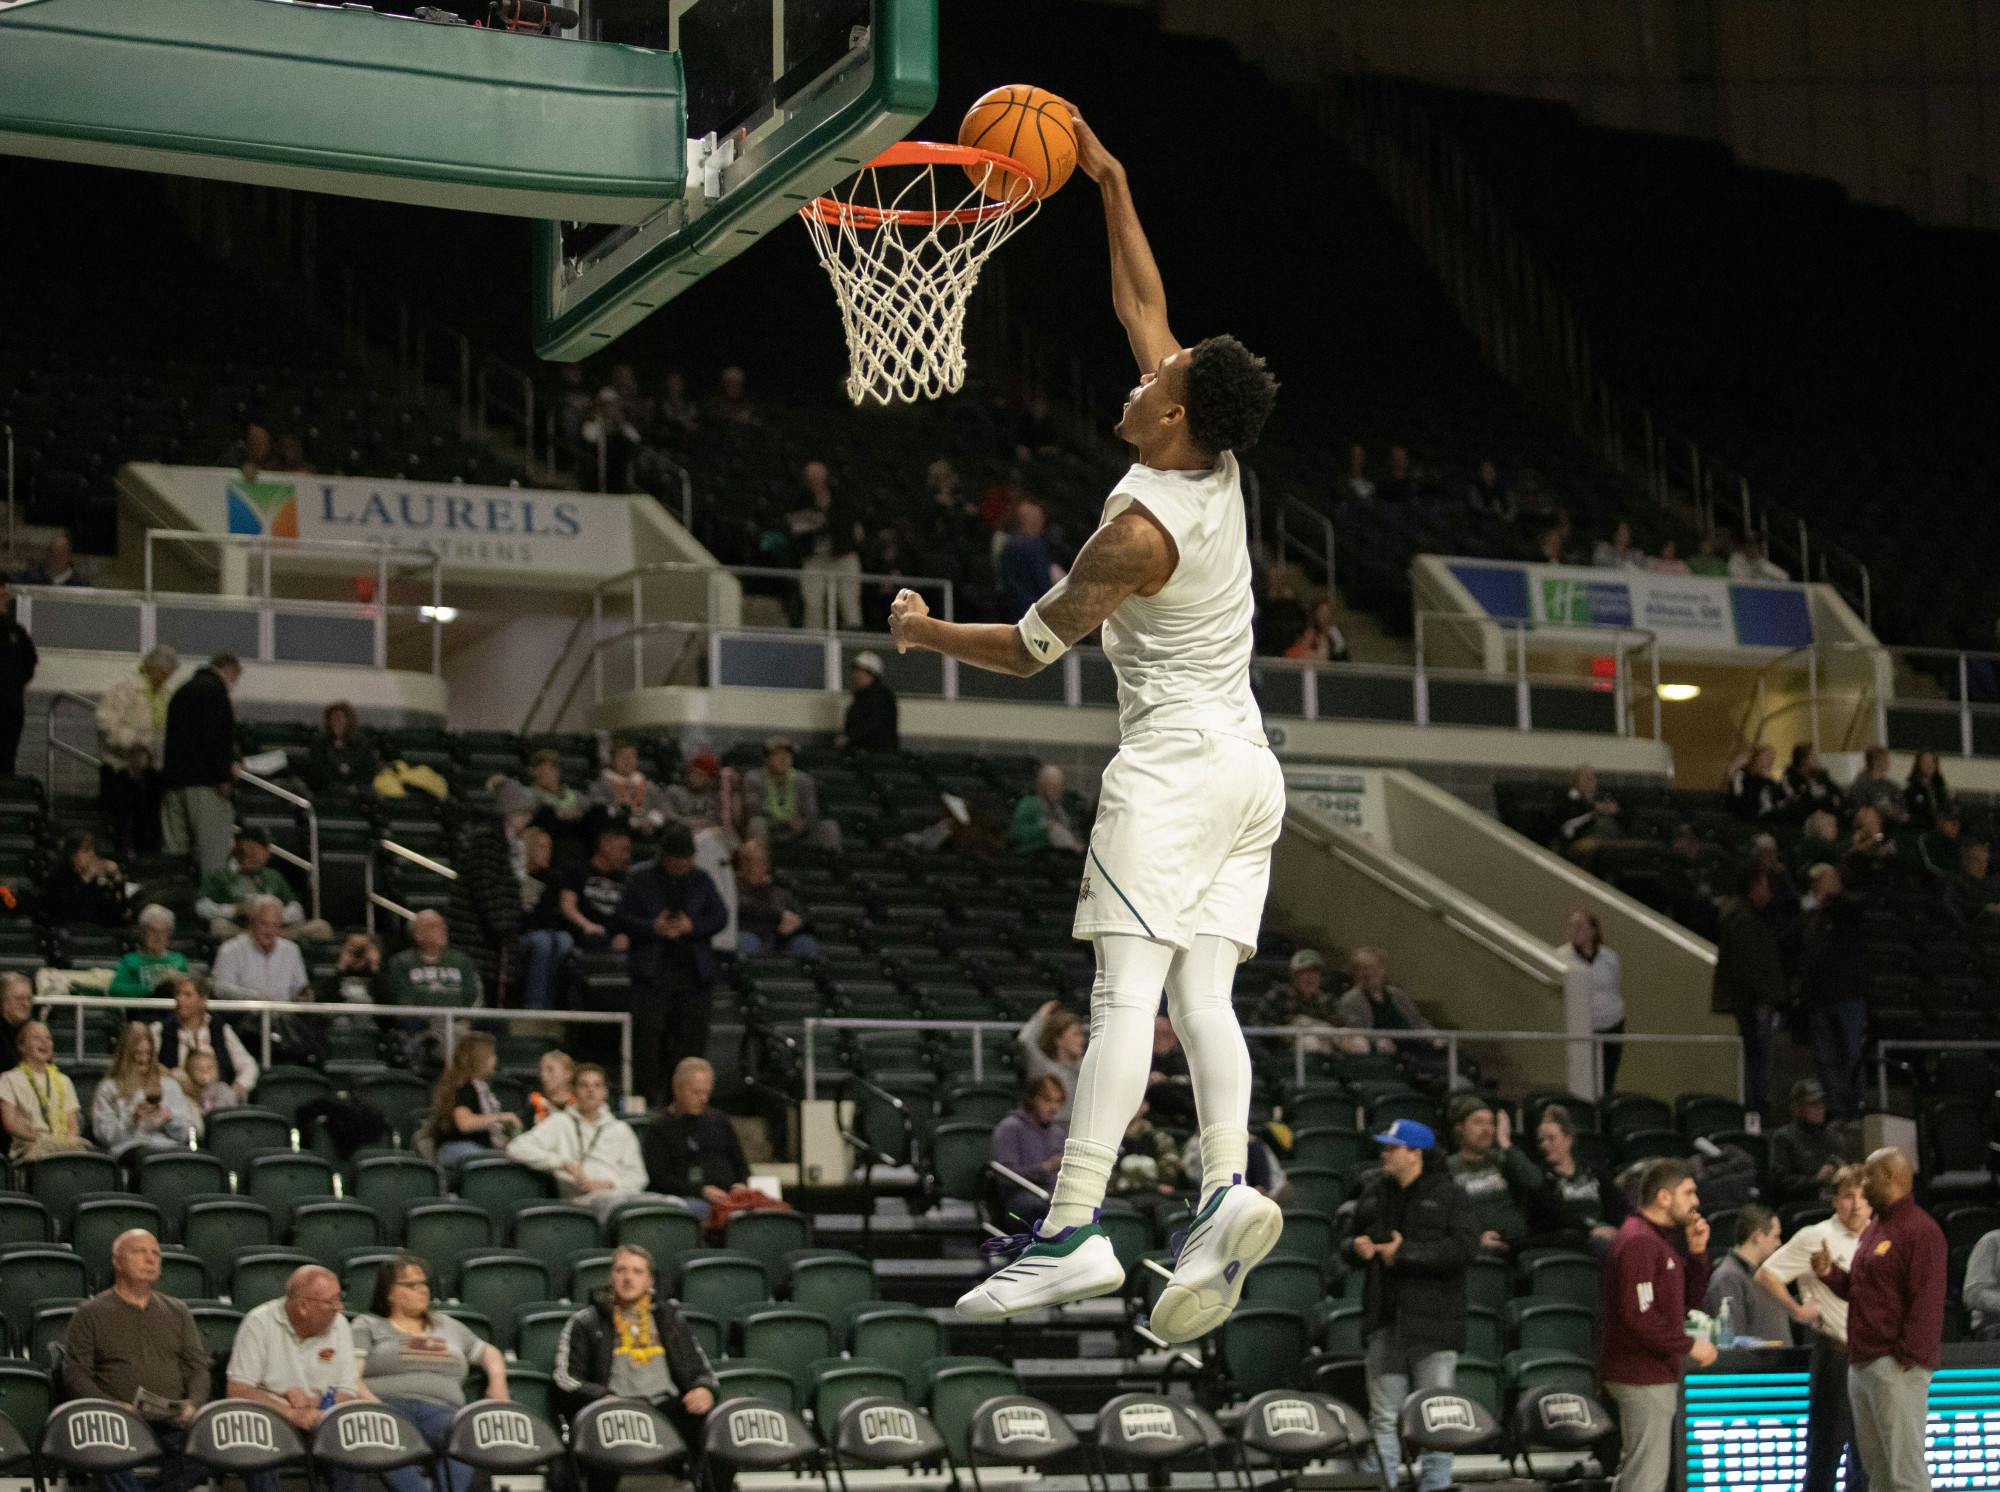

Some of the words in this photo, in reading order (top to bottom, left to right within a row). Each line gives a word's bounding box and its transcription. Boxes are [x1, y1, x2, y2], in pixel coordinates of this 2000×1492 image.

[321, 484, 581, 538] LAURELS
[68, 1410, 129, 1450] OHIO
[212, 1411, 273, 1450] OHIO
[338, 1411, 399, 1450] OHIO
[472, 1410, 534, 1449] OHIO
[596, 1409, 657, 1449] OHIO
[729, 1408, 788, 1447] OHIO
[859, 1406, 918, 1445] OHIO
